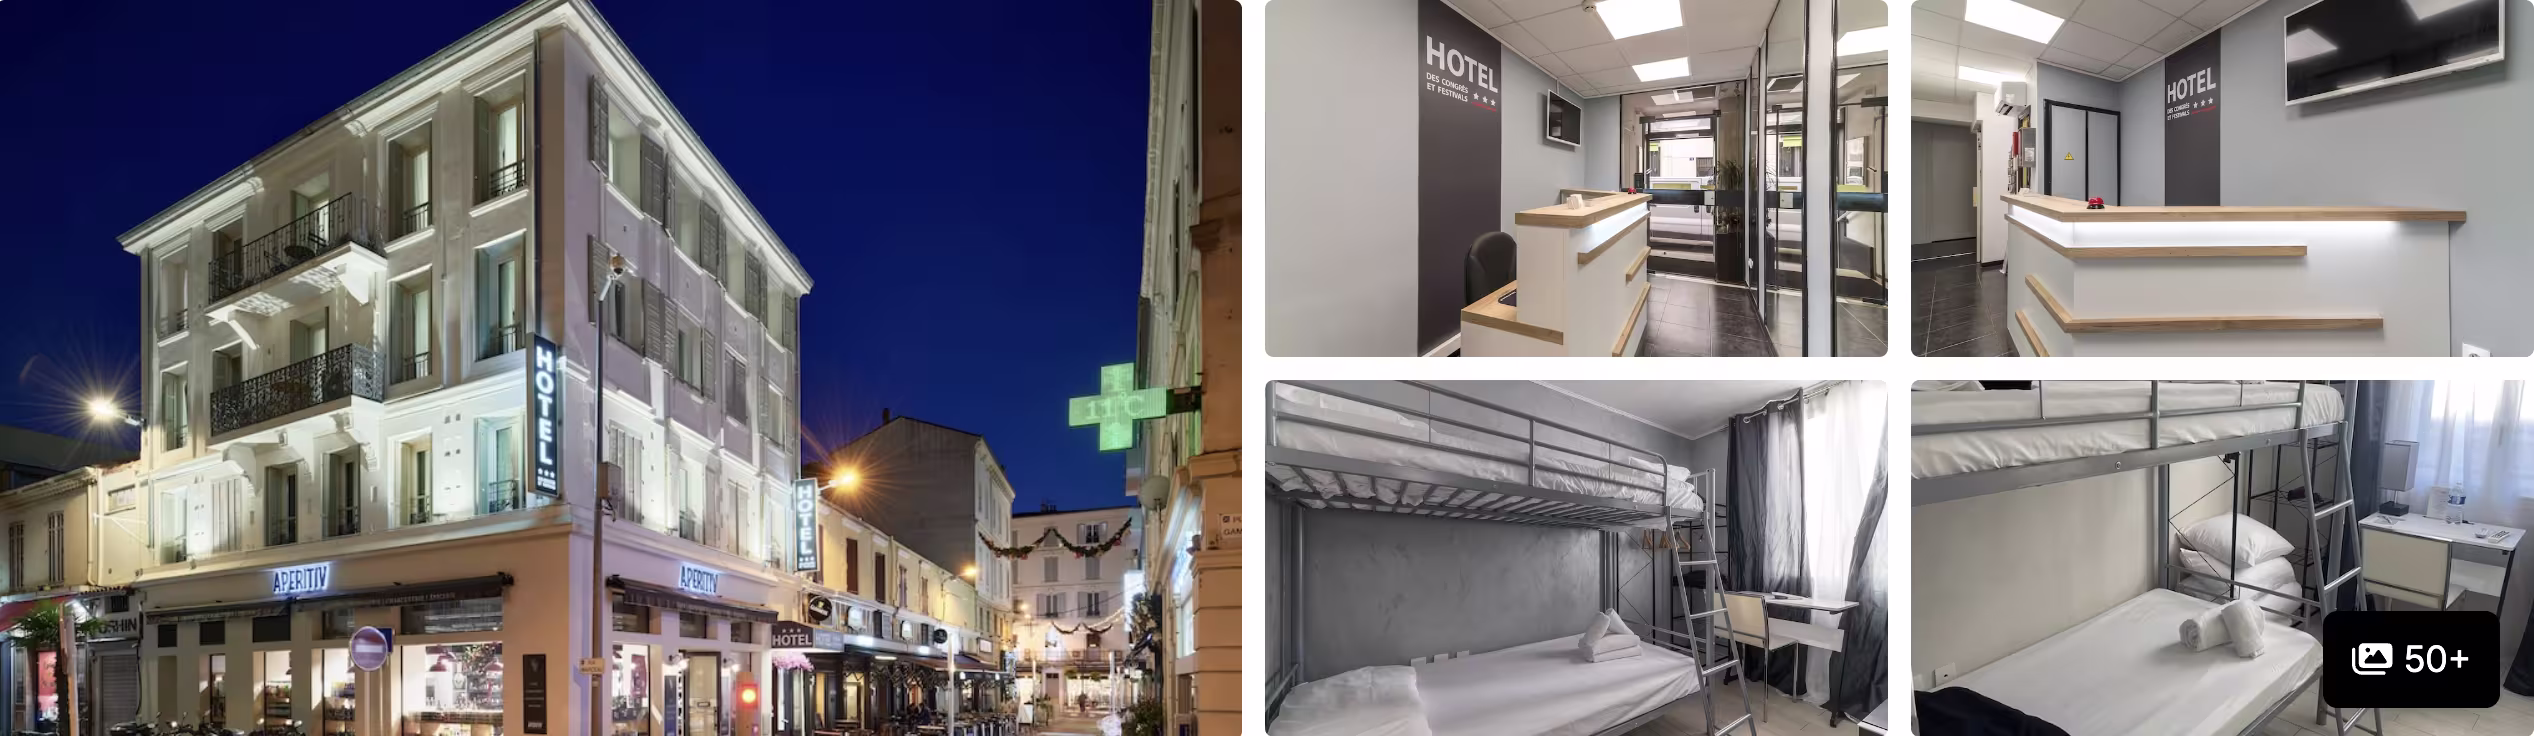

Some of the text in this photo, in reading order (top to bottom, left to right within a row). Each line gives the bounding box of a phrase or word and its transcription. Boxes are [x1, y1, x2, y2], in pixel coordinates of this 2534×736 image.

[1426, 35, 1498, 93] HOTEL
[1426, 72, 1469, 94] DES CONGRÈS
[1426, 82, 1469, 102] ET FESTIVALS
[2167, 67, 2216, 104] HOTEL
[535, 345, 555, 466] HOTEL
[797, 484, 814, 556] HOTEL
[273, 565, 328, 593] APERITIV
[680, 565, 719, 593] APERITIV
[772, 634, 813, 647] HOTEL
